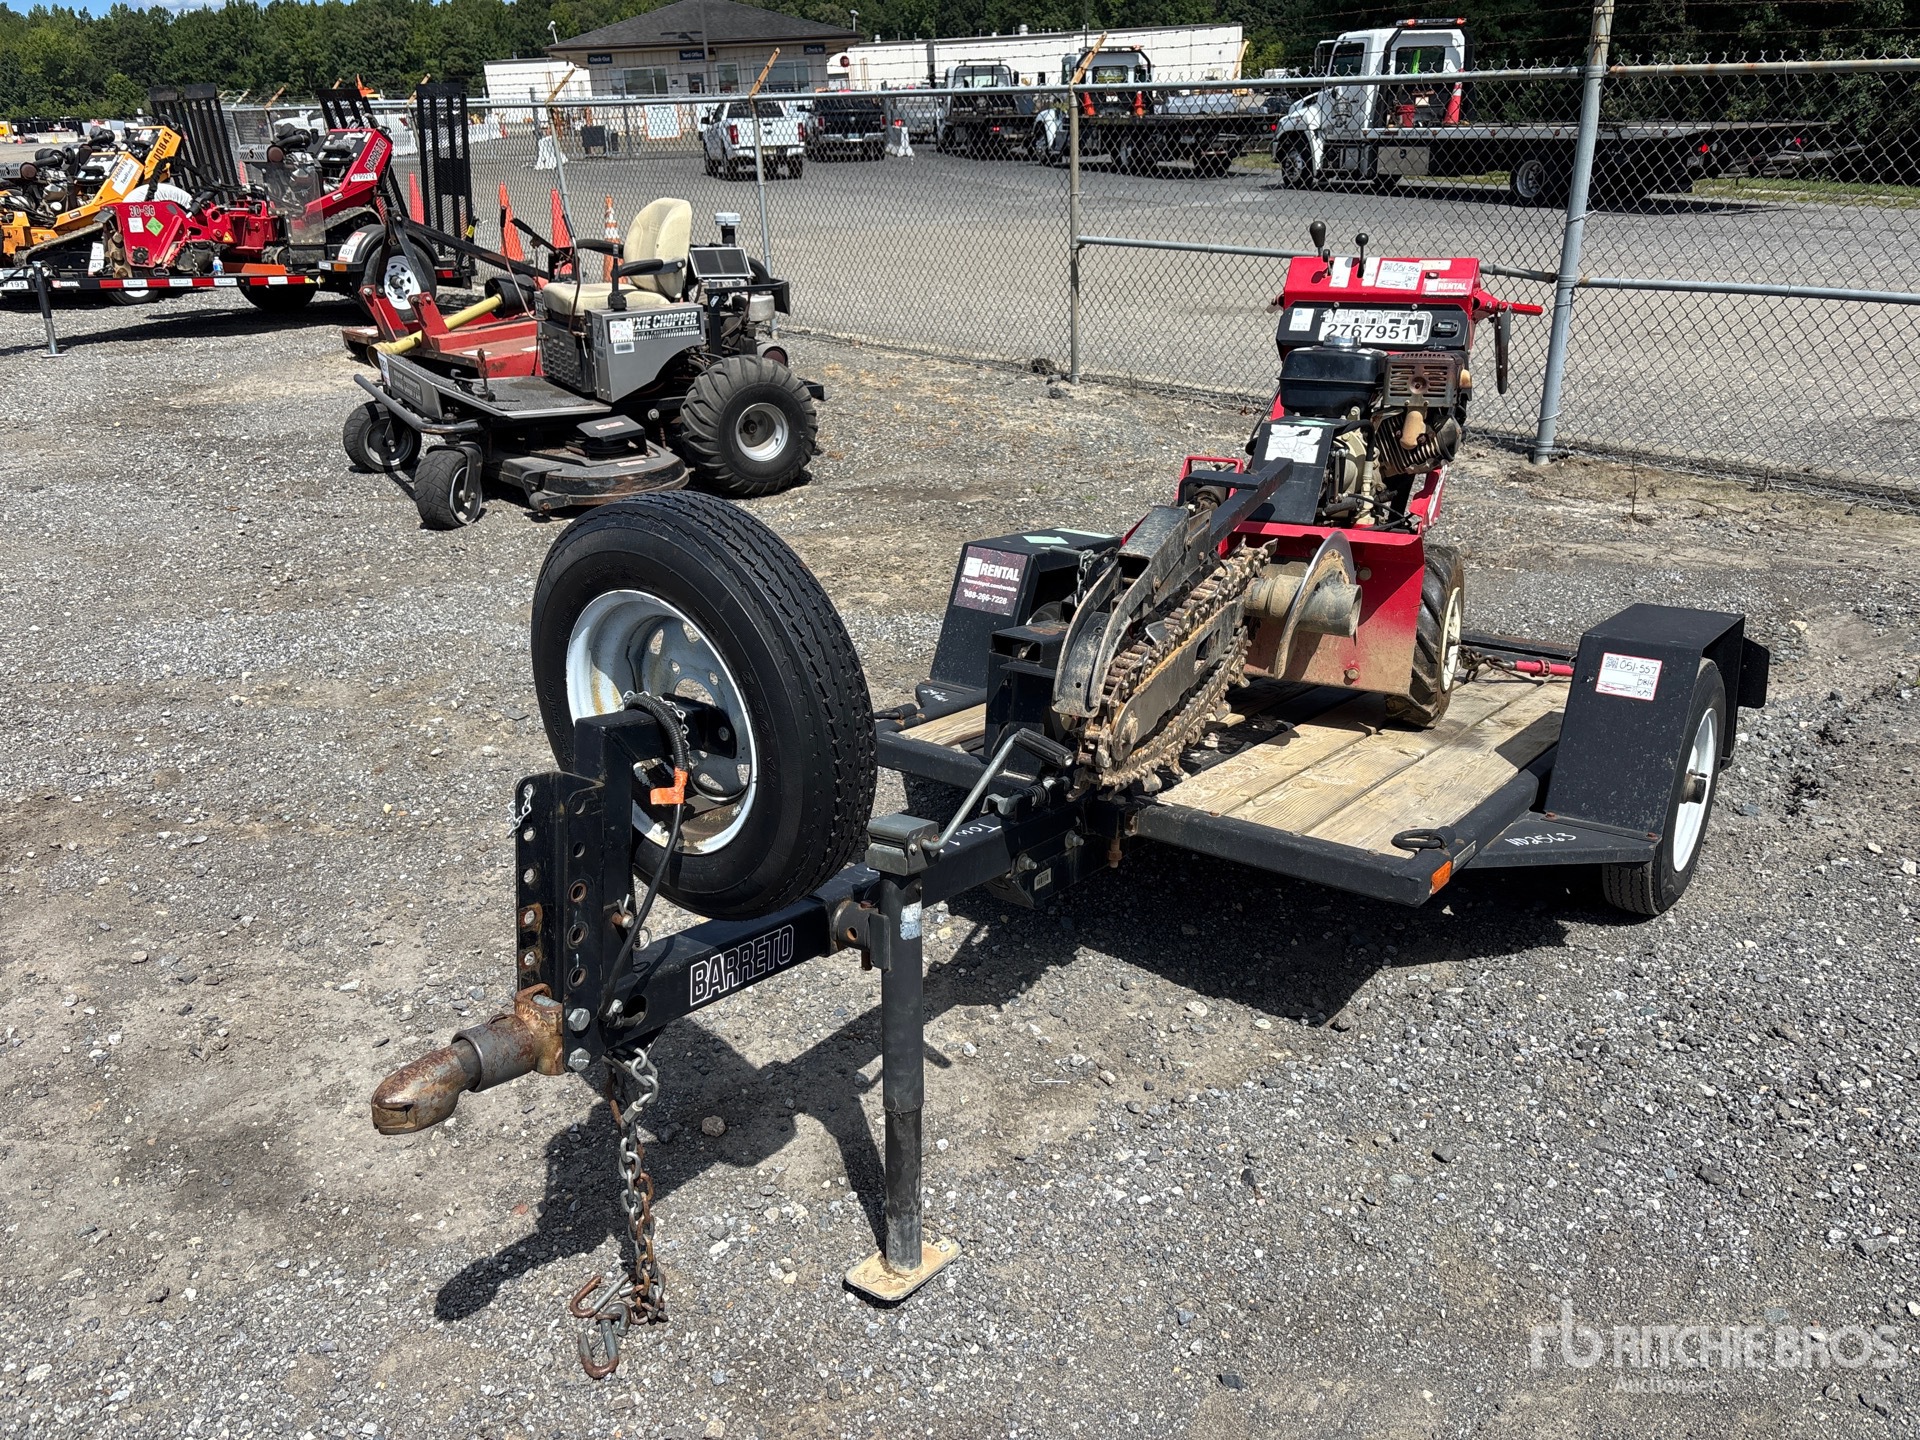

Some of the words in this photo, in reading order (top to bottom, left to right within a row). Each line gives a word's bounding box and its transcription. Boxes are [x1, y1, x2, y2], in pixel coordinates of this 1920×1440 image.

[364, 138, 387, 172] BARRETO
[1437, 282, 1467, 291] RENTAL
[652, 312, 698, 328] CHOPPER
[1327, 323, 1413, 340] 2767951
[980, 563, 1020, 582] RENTAL
[1620, 660, 1658, 675] 051-557
[690, 924, 794, 1007] BARRETO
